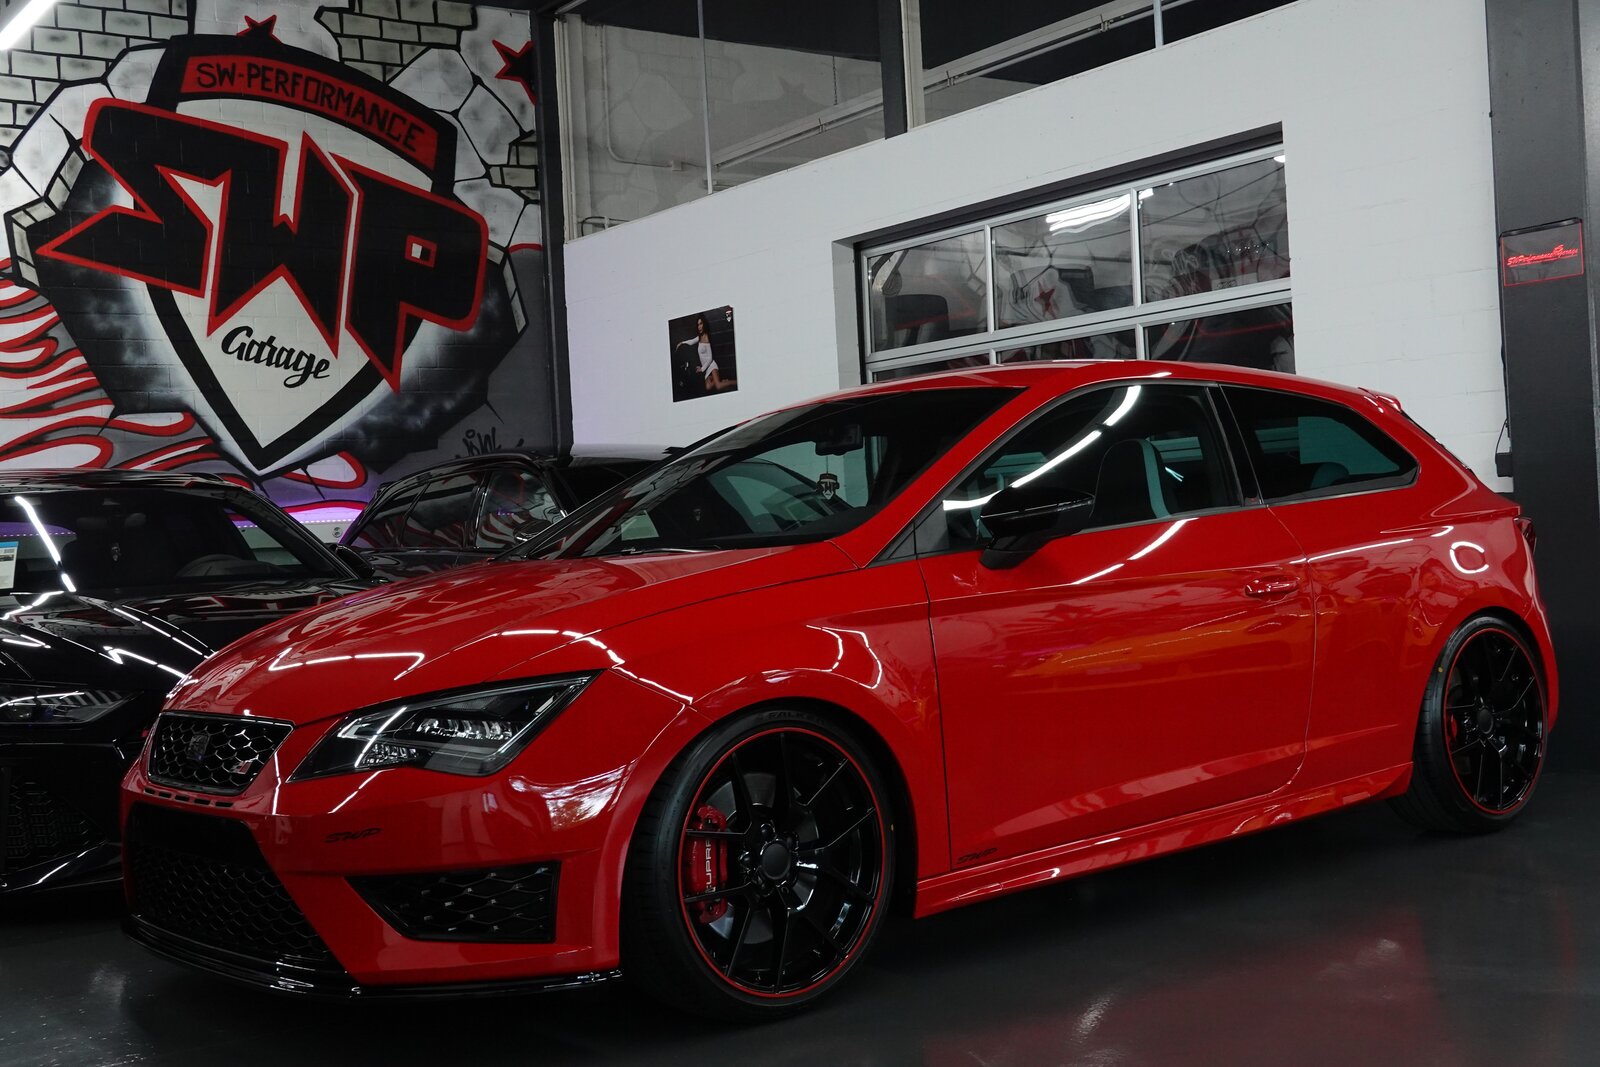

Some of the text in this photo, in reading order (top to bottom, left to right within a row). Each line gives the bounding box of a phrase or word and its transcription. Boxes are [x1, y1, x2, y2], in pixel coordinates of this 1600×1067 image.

[196, 62, 425, 153] SW-PERFORMANCE
[36, 97, 489, 394] SWP
[221, 325, 330, 388] Garage
